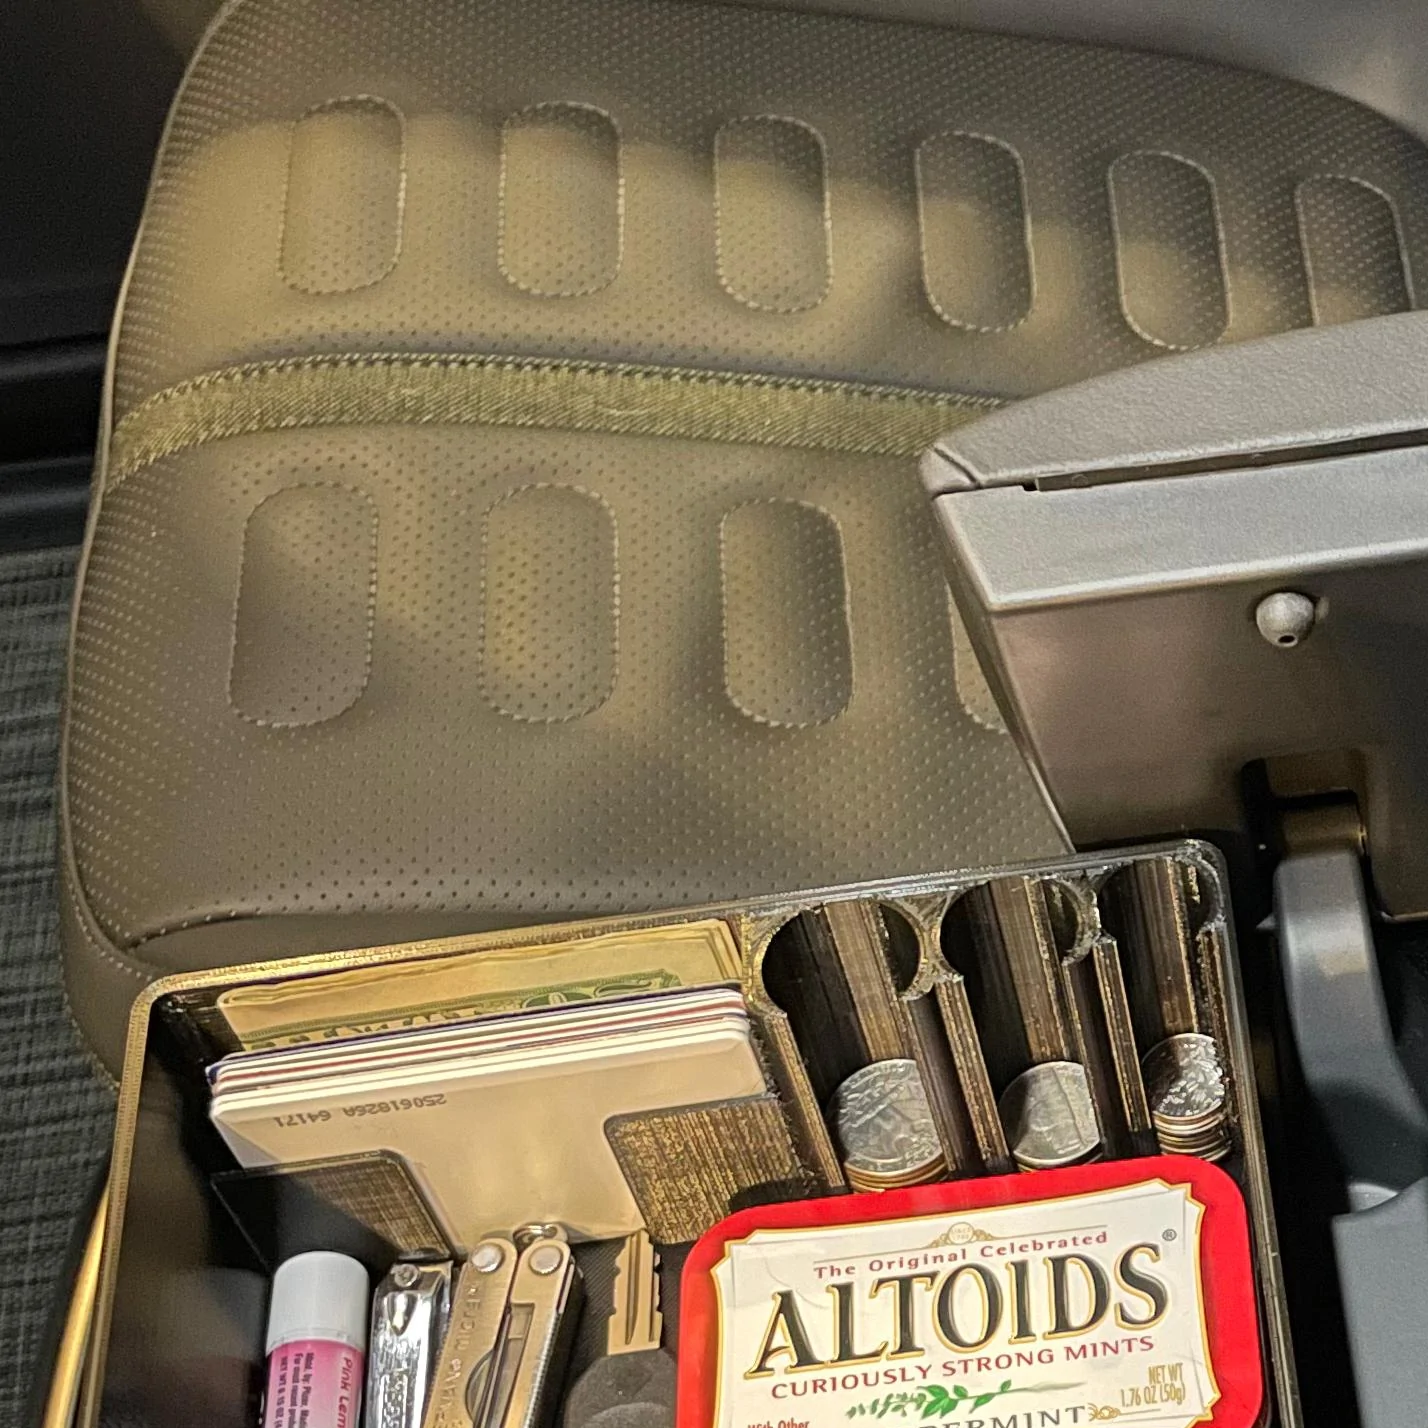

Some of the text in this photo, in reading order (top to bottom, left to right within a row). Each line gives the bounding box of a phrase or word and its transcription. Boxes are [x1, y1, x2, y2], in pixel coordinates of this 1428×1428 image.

[273, 1093, 448, 1128] 25061826A 64171
[814, 1231, 1108, 1280] The Original Celebrated
[743, 1242, 1169, 1380] ALTOIDS
[339, 1357, 353, 1391] Pink
[771, 1335, 1155, 1400] CURIOUSLY STRONG MINTS
[1148, 1362, 1183, 1385] NET WT
[1120, 1382, 1186, 1407] 1.76 OZ (50g)
